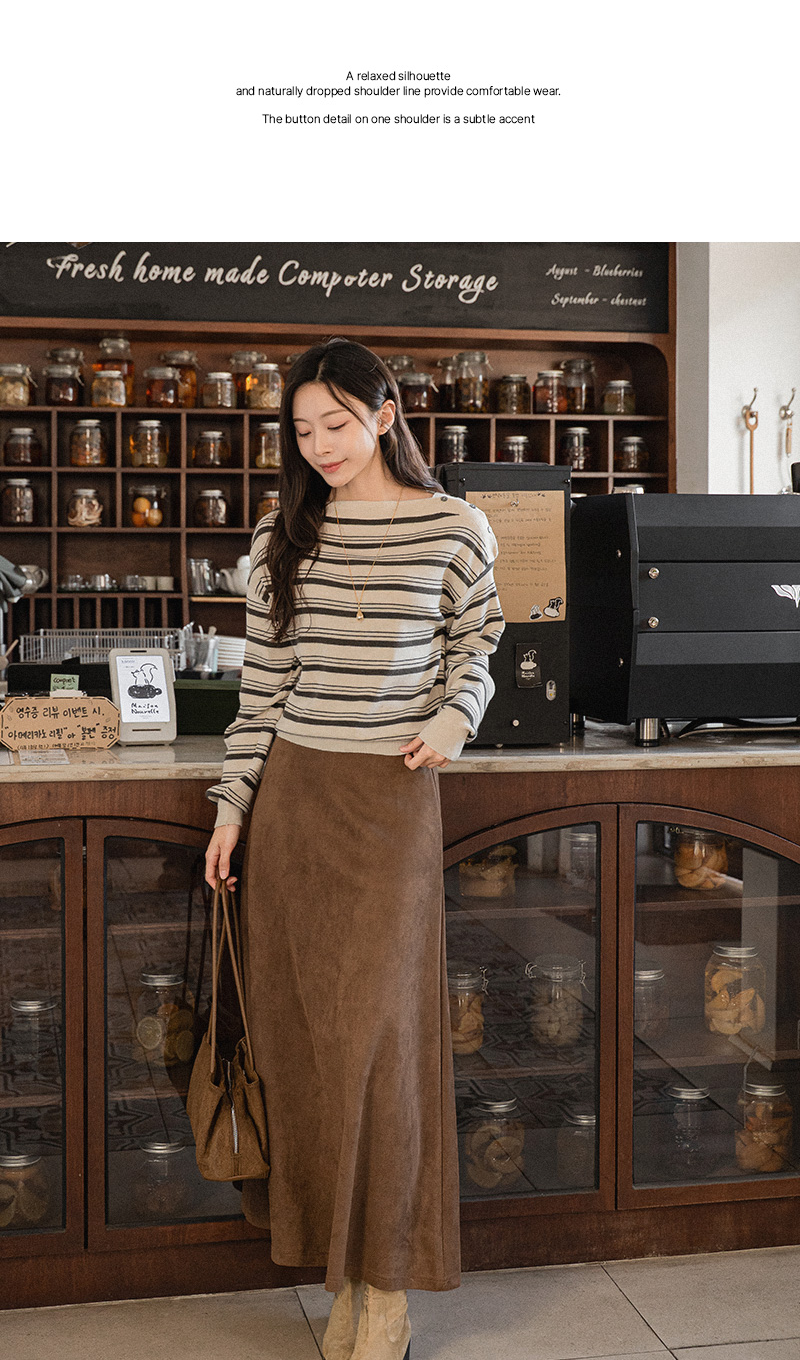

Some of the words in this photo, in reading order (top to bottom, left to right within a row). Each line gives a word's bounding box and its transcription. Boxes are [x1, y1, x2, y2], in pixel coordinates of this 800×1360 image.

[46, 250, 127, 283] Fresh
[133, 251, 196, 284] home
[204, 255, 270, 285] made
[401, 263, 499, 304] Storage
[545, 263, 578, 281] August
[592, 263, 643, 277] Blueberries
[551, 291, 600, 308] September
[16, 706, 39, 719] 영수증
[42, 705, 60, 719] 리뷰
[62, 706, 89, 719] 이벤트
[101, 725, 116, 740] 증정
